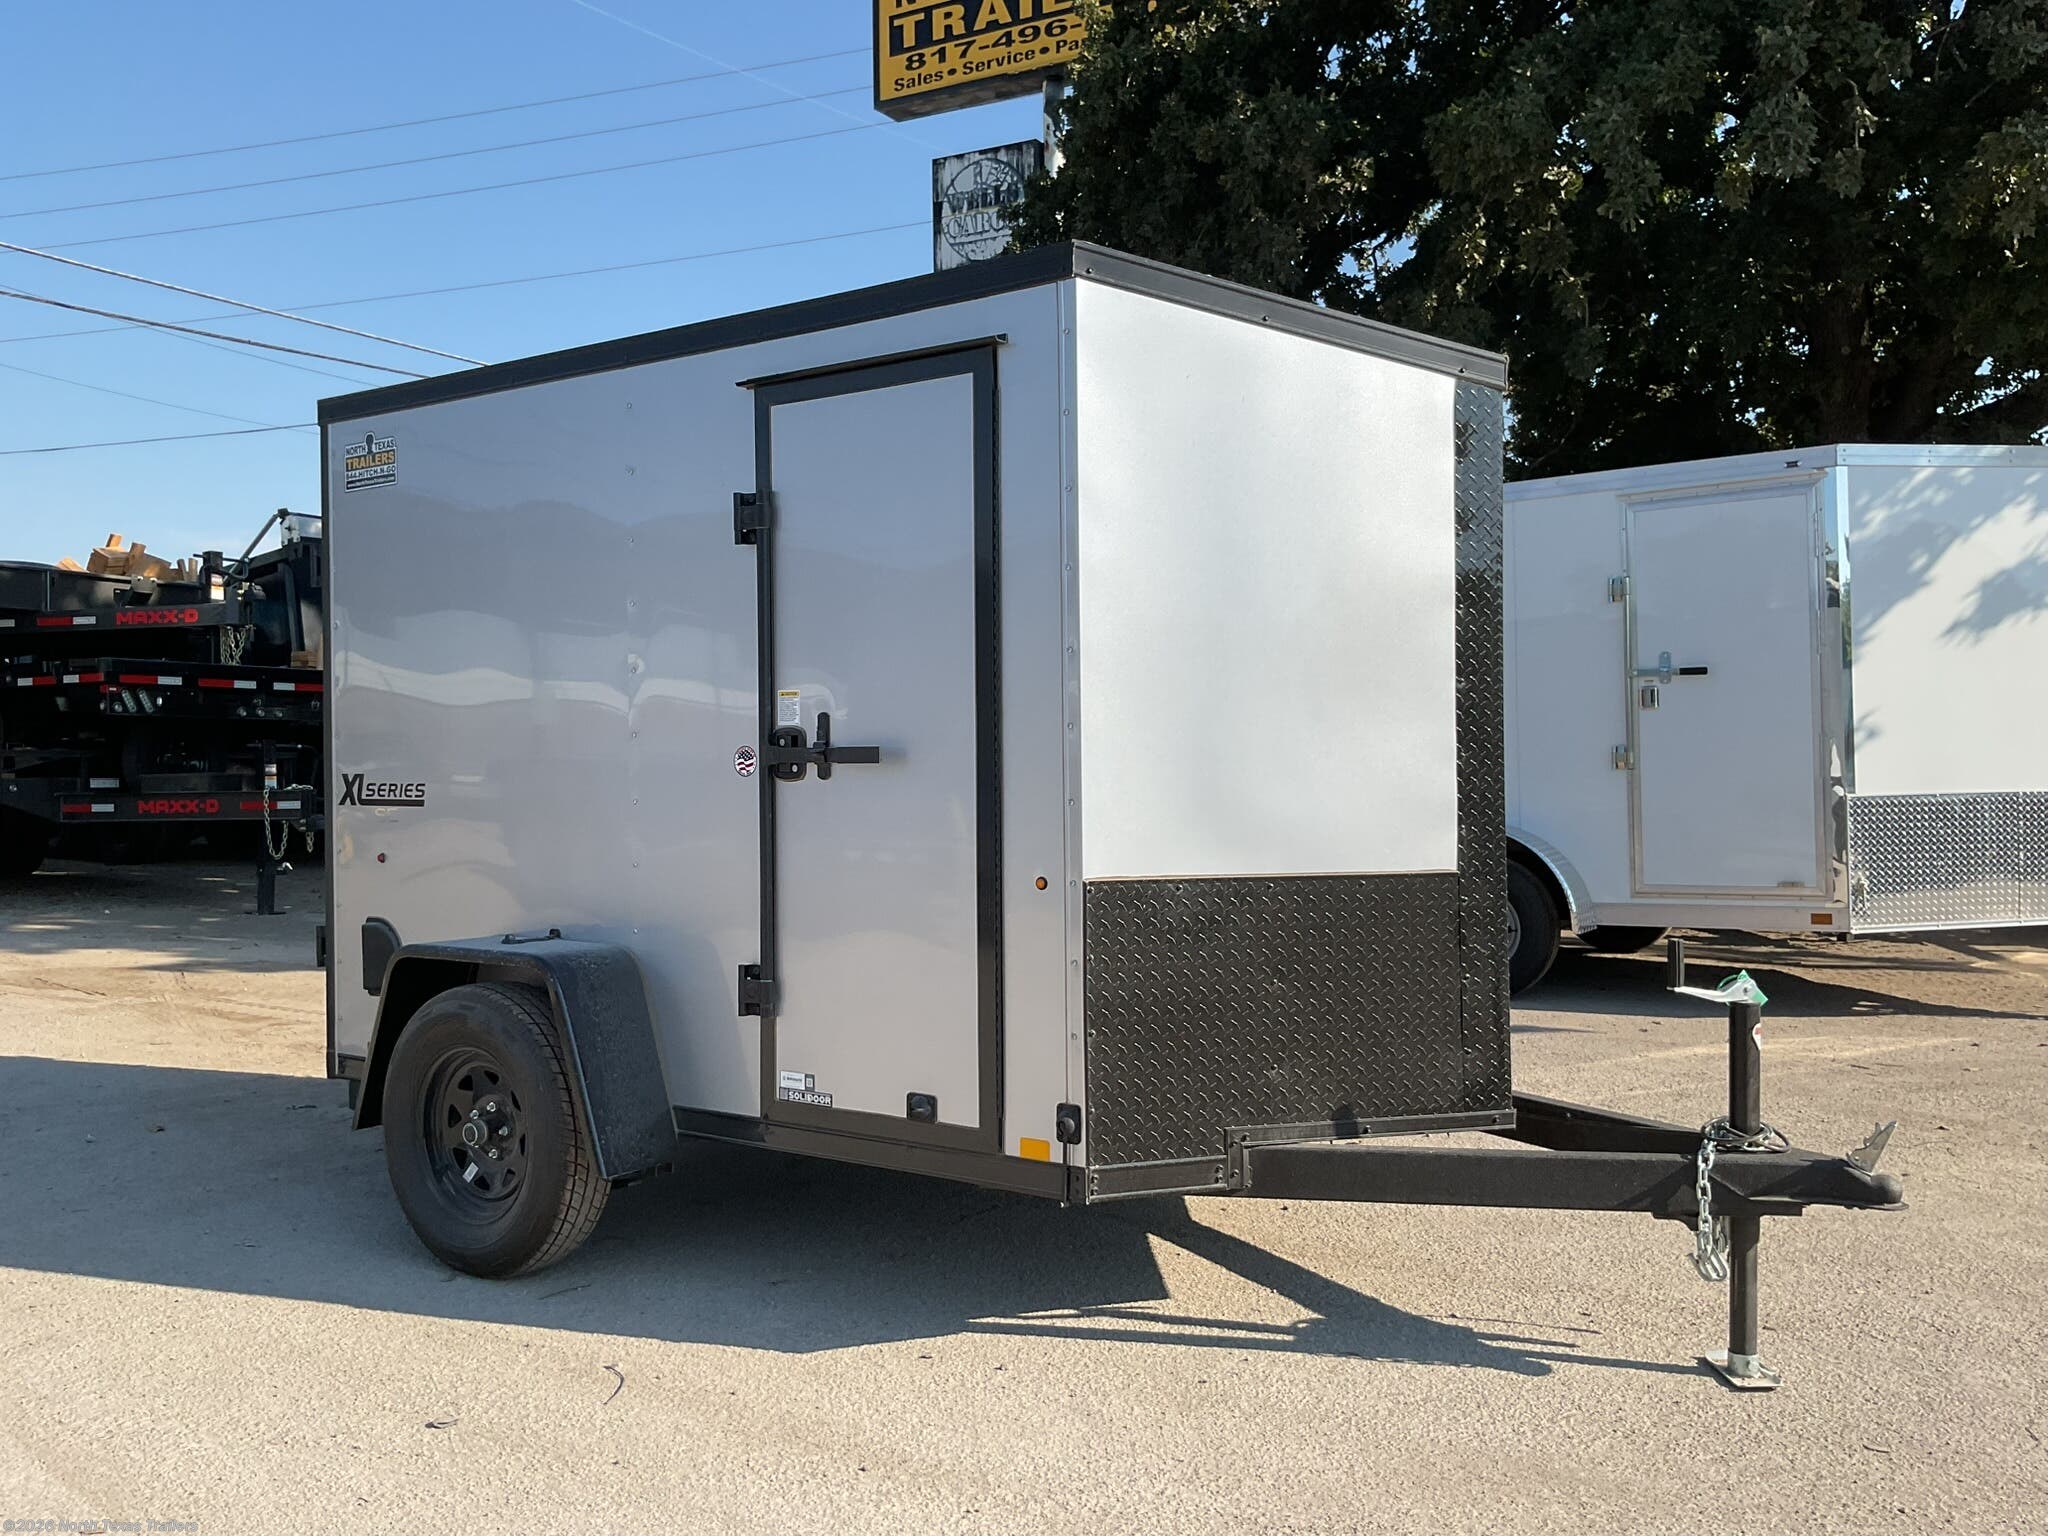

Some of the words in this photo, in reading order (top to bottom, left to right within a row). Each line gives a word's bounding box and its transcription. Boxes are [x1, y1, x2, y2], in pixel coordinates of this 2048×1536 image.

[894, 68, 943, 92] Sales
[962, 48, 1035, 75] Service
[346, 444, 366, 456] NORTH
[374, 439, 394, 451] TEXAS
[347, 452, 394, 470] TRAILERS
[116, 608, 198, 625] MAXX-D
[338, 773, 365, 806] XL
[366, 782, 426, 798] SERIES
[138, 799, 220, 814] MAXX-D
